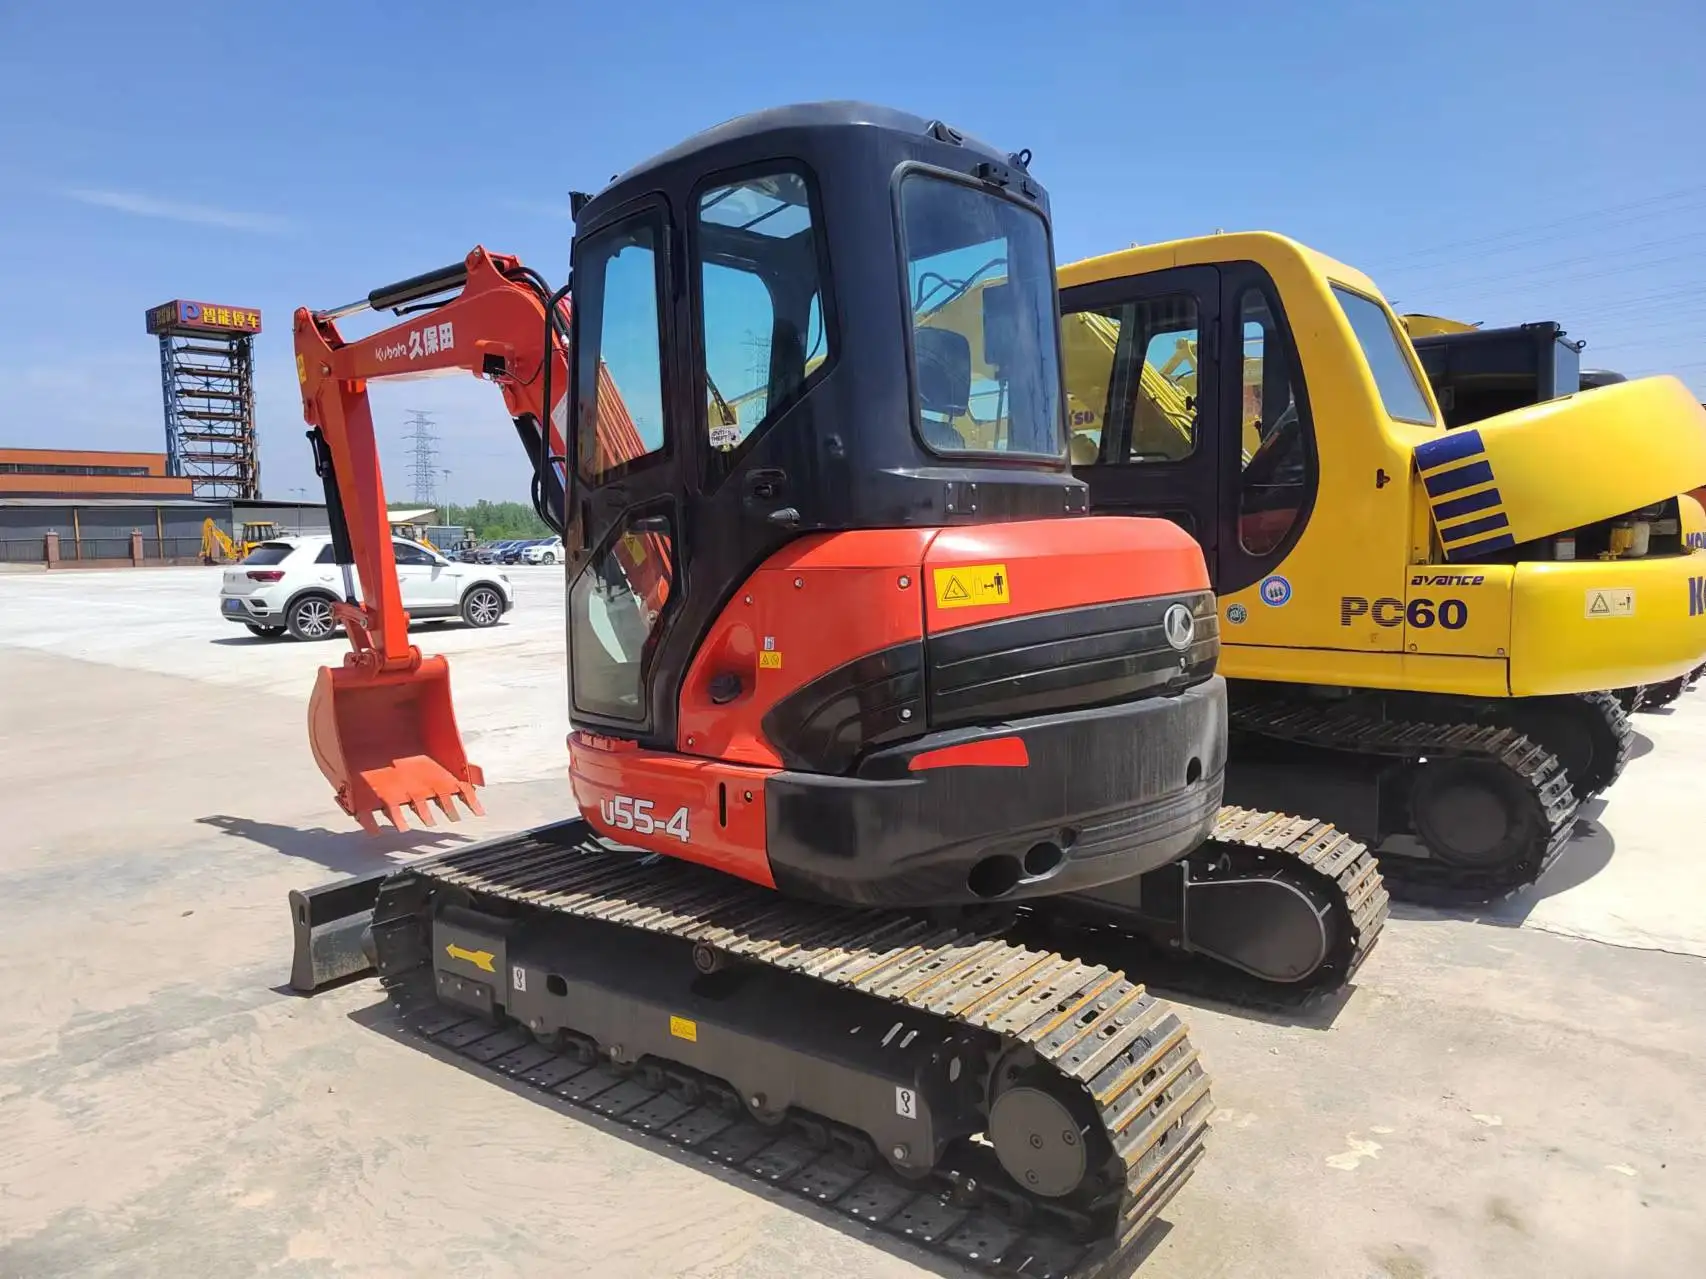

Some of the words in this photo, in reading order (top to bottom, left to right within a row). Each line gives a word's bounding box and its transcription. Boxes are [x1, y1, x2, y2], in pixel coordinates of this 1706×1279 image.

[202, 306, 259, 329] 智能停车
[375, 342, 407, 362] Kubota
[408, 322, 454, 360] 久保田
[1340, 596, 1468, 630] PC60
[600, 795, 690, 843] U55-4
